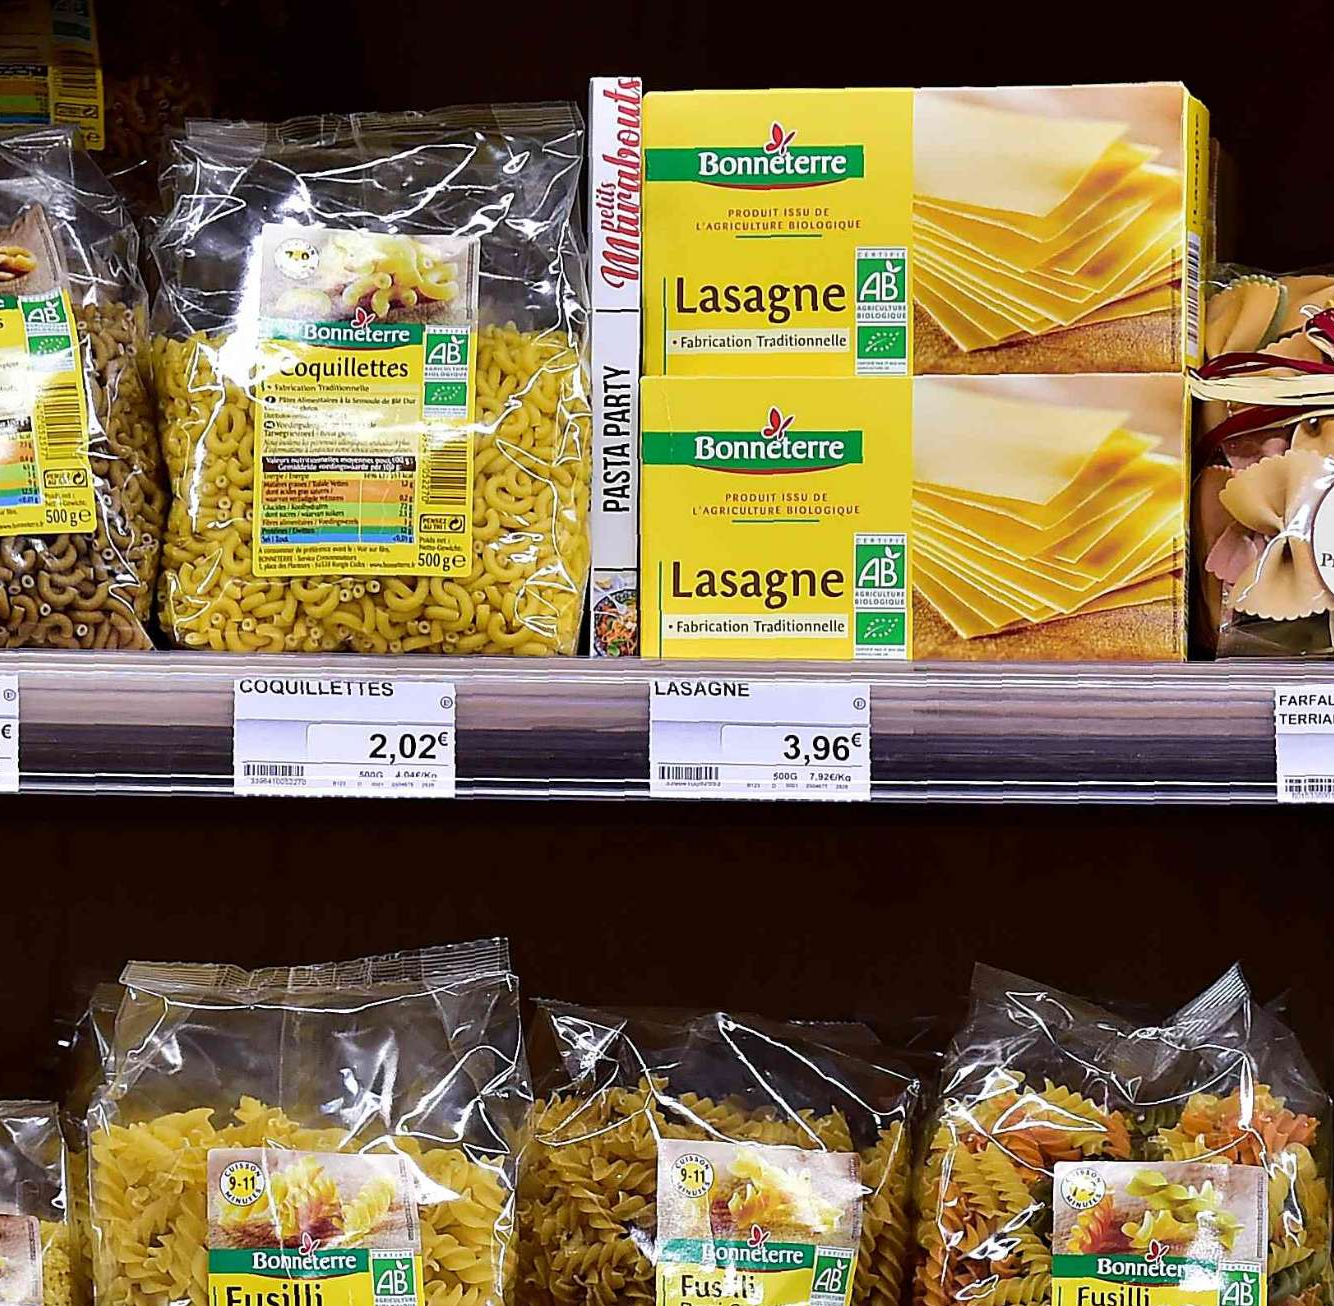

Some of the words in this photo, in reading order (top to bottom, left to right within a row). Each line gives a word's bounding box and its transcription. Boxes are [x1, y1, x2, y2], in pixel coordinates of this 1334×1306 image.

[698, 151, 847, 176] Bonneterre
[600, 78, 641, 289] Marabouts
[595, 182, 616, 231] petits
[728, 208, 779, 218] PRODUIT
[783, 208, 811, 217] ISSU
[815, 208, 829, 217] DE
[696, 221, 784, 230] L'AGRICULTURE
[789, 220, 861, 230] BIOLOGIQUE
[676, 277, 846, 324] Lasagne
[302, 324, 410, 343] Bonneterre
[681, 336, 752, 348] Fabrication
[756, 335, 847, 347] Traditionnelle
[603, 365, 630, 439] PARTY
[694, 436, 844, 461] Bonneterre
[603, 444, 630, 513] PASTA
[672, 561, 844, 609] Lasagne
[239, 680, 394, 697] COQUILLETTES
[655, 681, 750, 697] LASAGNE
[773, 772, 797, 780] 500G
[229, 1175, 257, 1191] 9-11
[252, 1252, 357, 1272] Bonneterre
